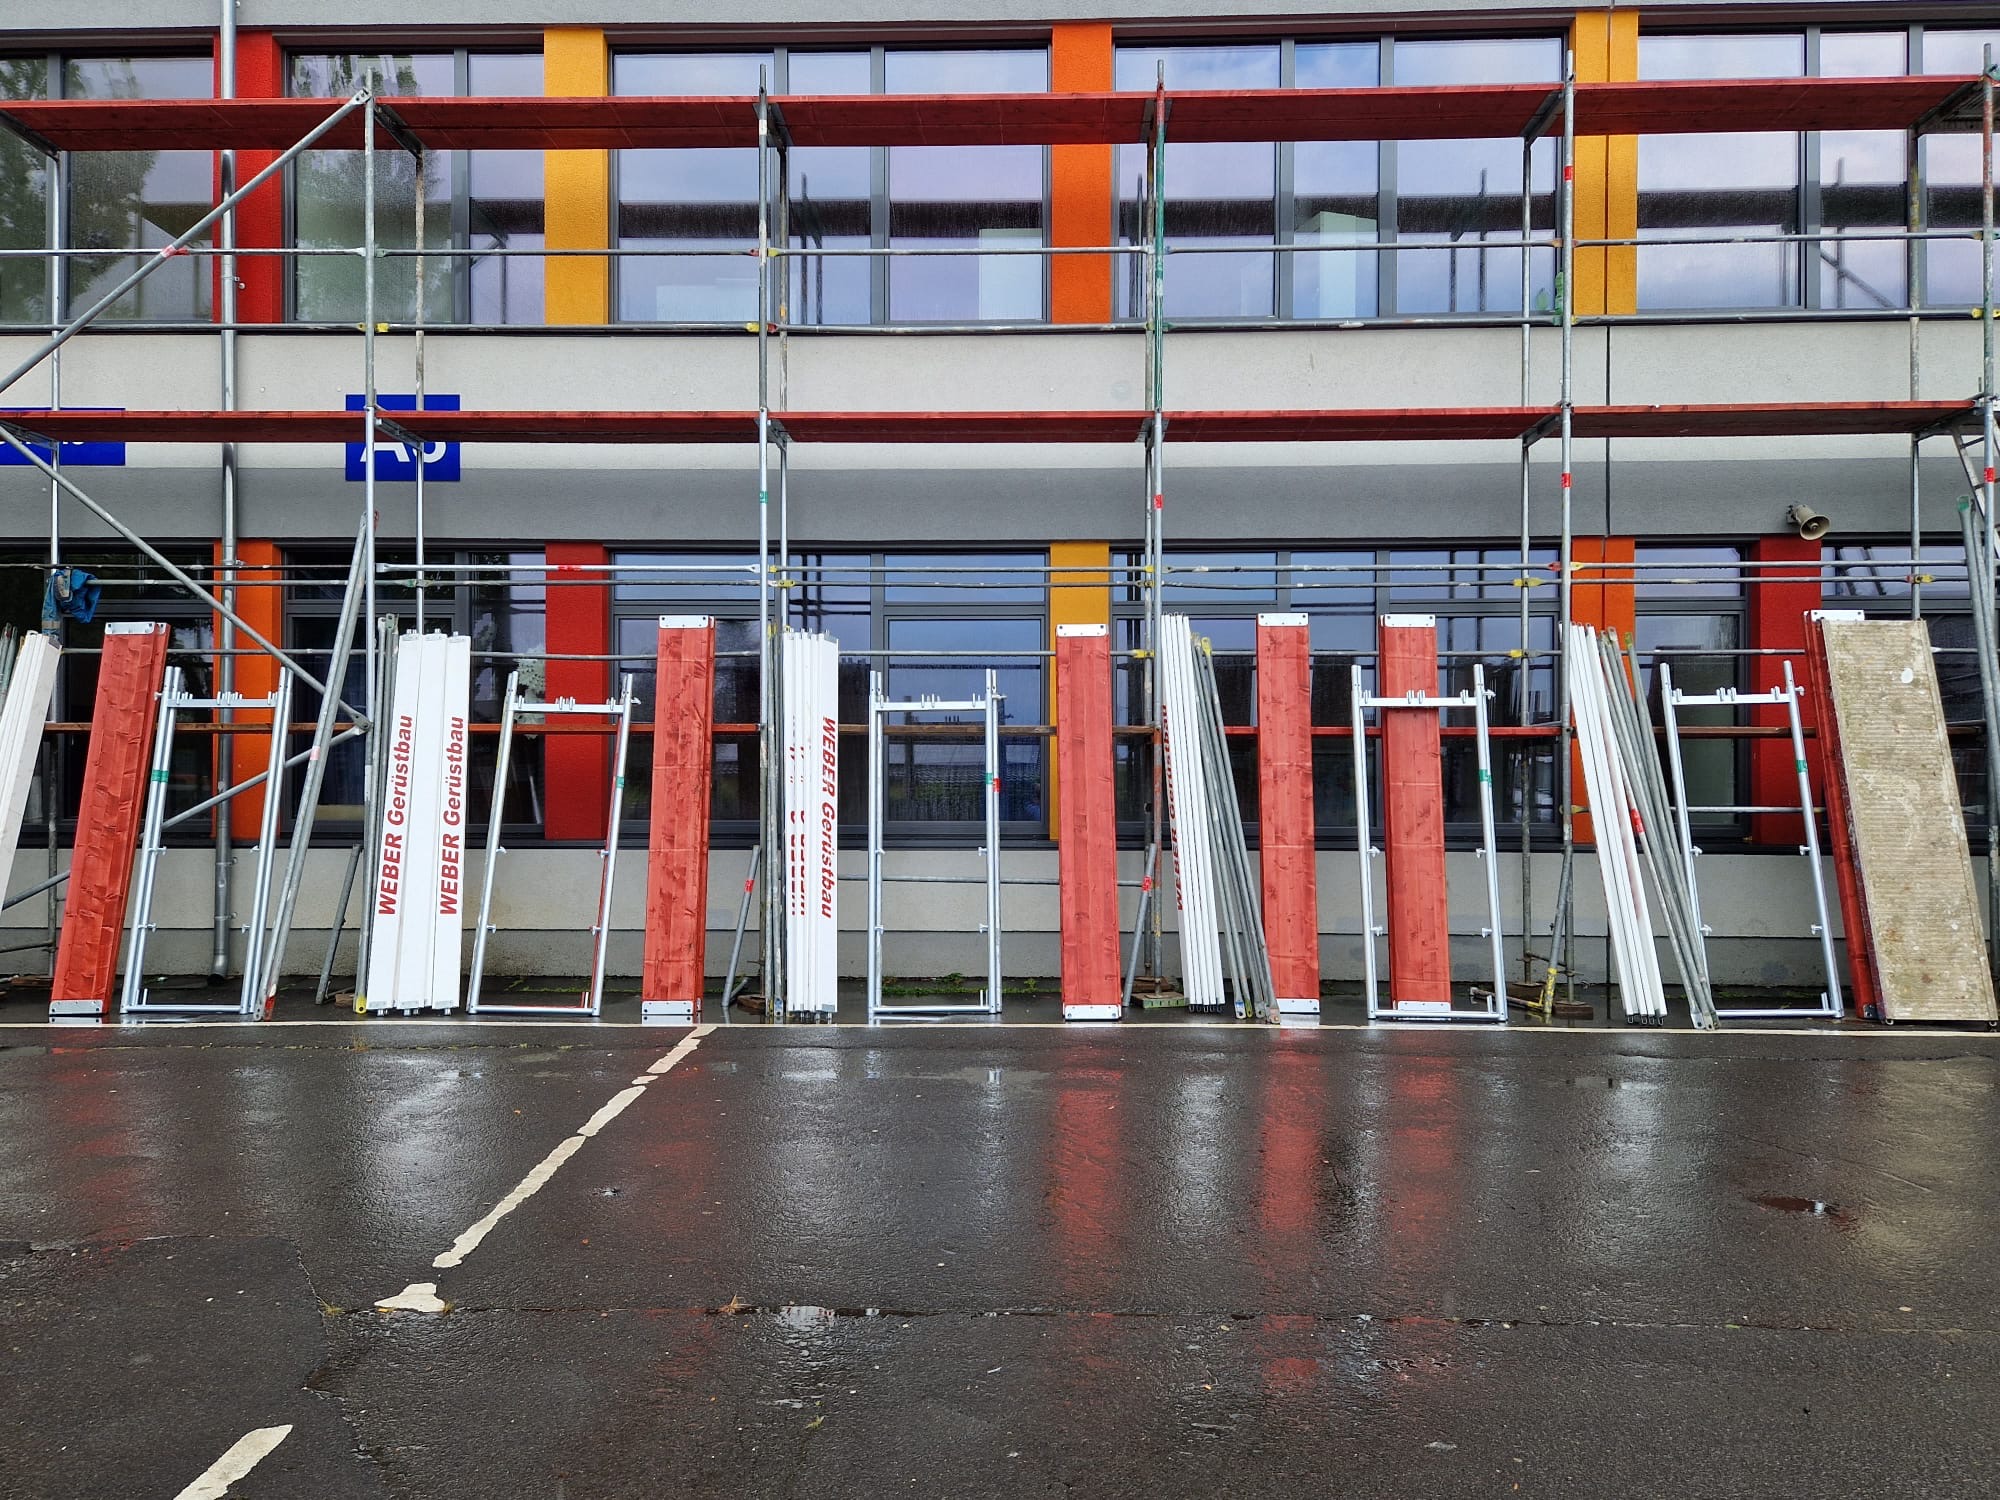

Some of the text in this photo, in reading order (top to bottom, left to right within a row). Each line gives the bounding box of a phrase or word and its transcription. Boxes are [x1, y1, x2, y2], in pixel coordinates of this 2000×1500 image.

[378, 715, 413, 915] WEBER Gerüstbau
[439, 716, 464, 915] WEBER Gerüstbau
[821, 716, 836, 919] WEBER Gerüstbau
